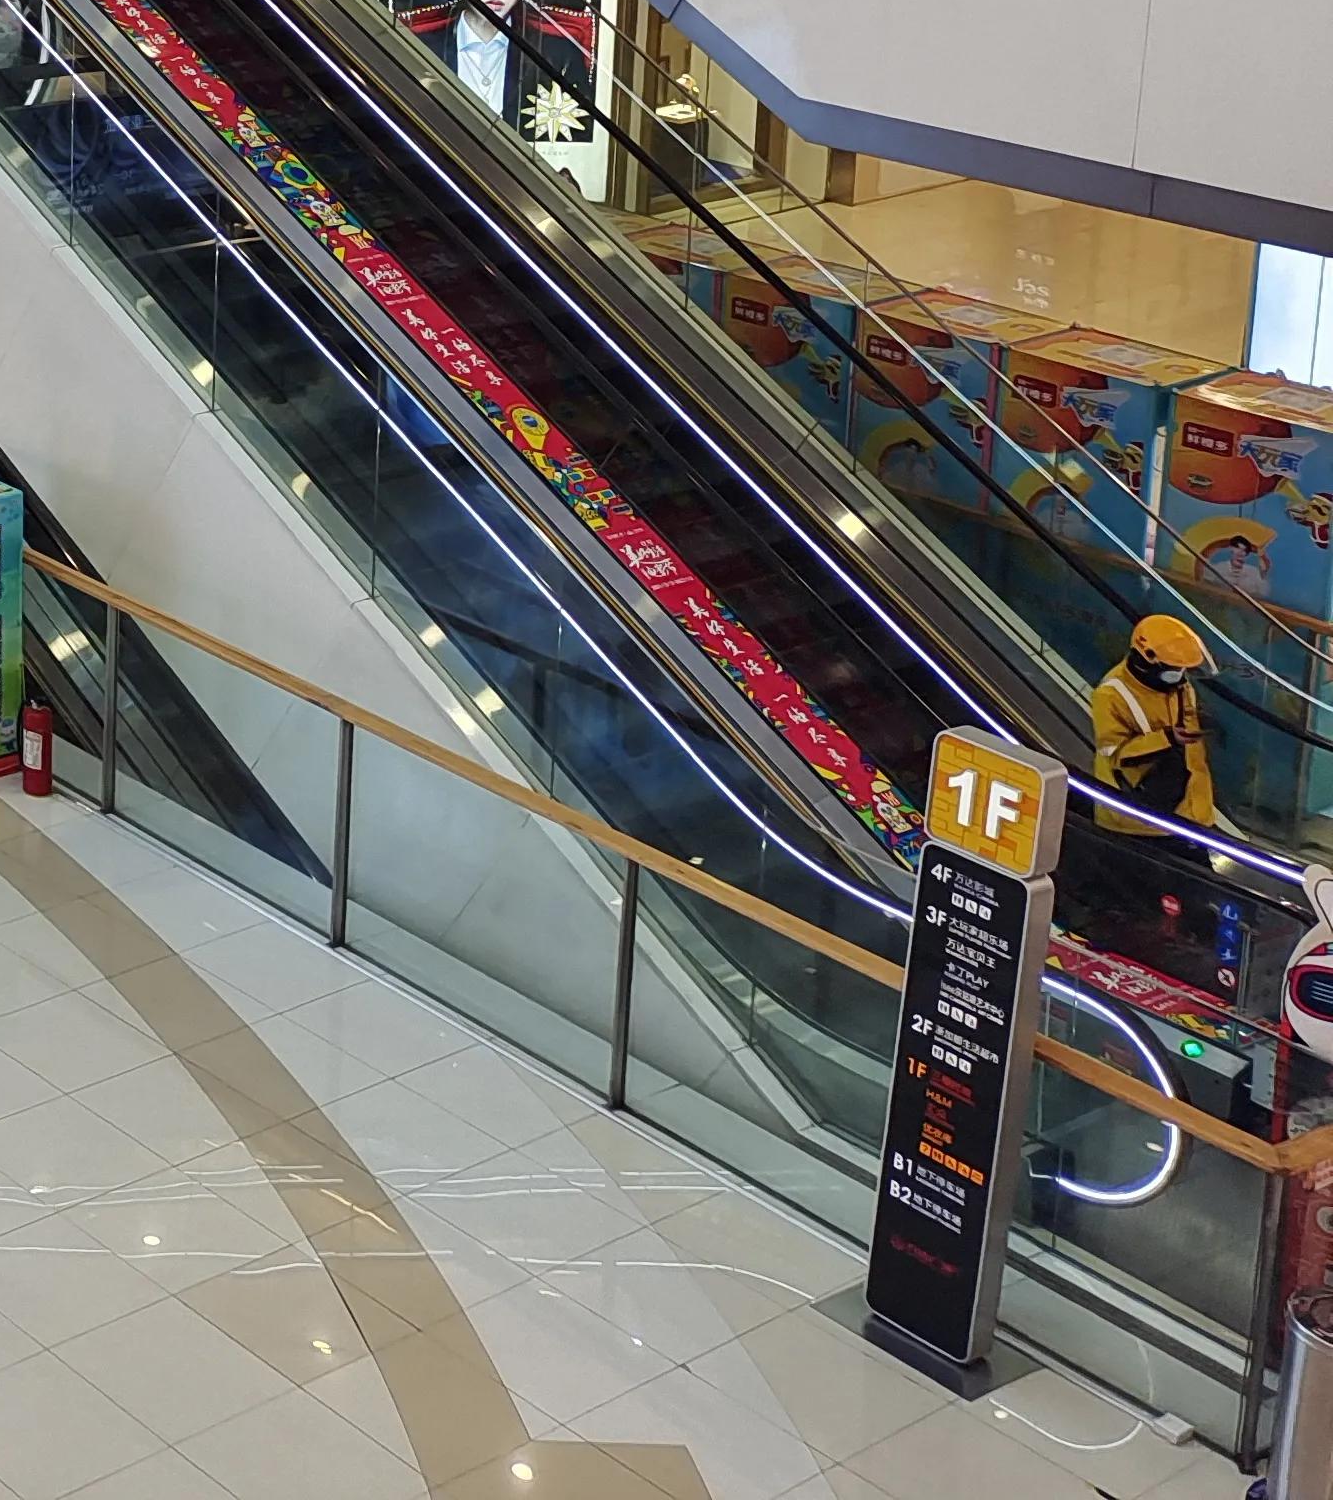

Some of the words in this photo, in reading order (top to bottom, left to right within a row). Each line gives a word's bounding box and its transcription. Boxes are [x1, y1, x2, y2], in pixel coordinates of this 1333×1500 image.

[949, 769, 1022, 840] 1F
[930, 863, 954, 885] 4F
[925, 905, 948, 927] 3F
[911, 1013, 934, 1036] 2F
[907, 1056, 928, 1079] 1F
[893, 1152, 913, 1176] B1
[889, 1179, 912, 1205] B2
